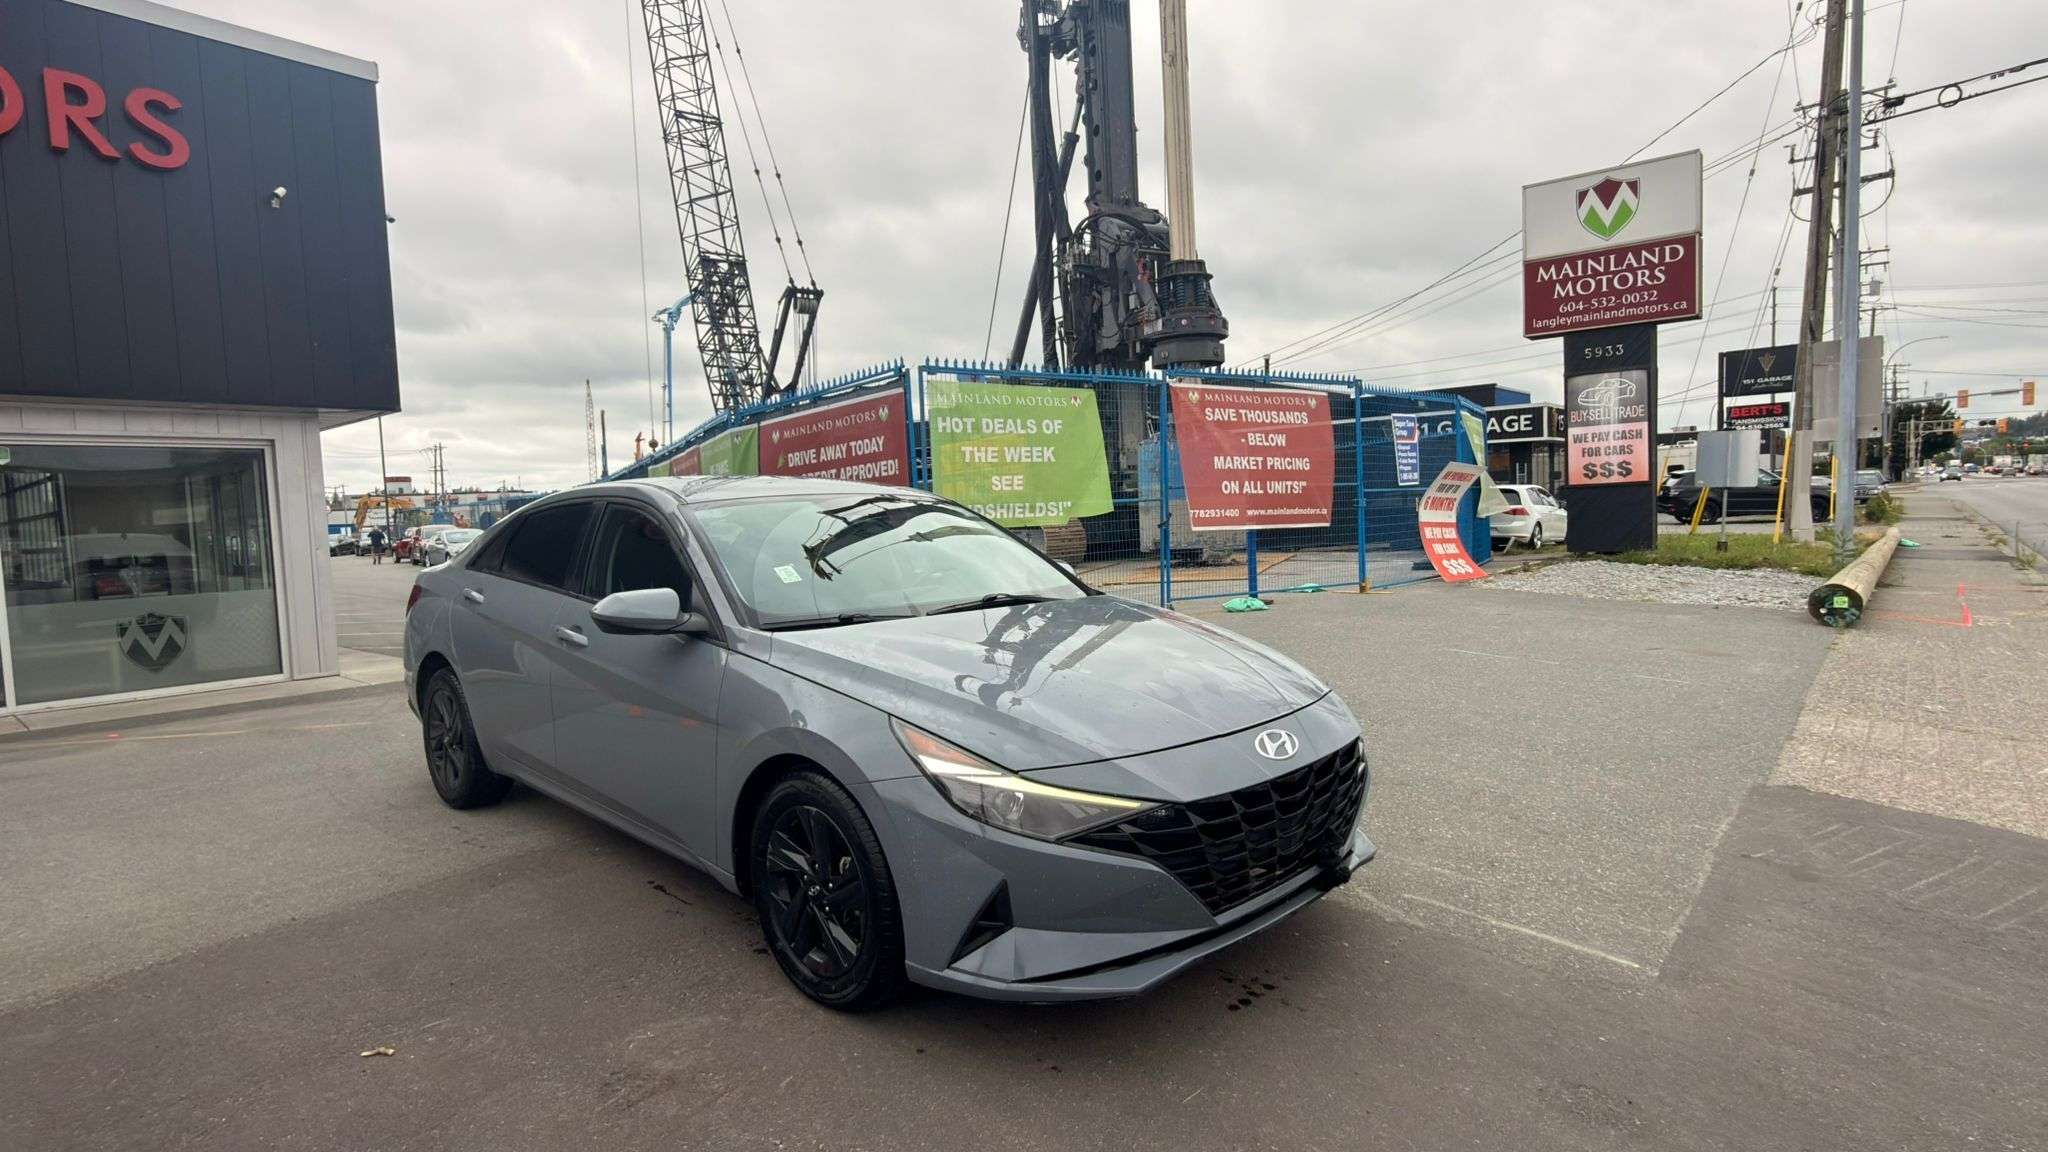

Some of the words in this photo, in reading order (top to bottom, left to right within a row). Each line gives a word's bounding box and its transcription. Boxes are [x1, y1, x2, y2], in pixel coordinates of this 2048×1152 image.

[1535, 244, 1685, 283] MAINLAND
[1553, 266, 1666, 299] MOTORS
[1559, 290, 1658, 313] 604-532-0032
[1532, 300, 1688, 328] langleymainlandmotors.ca
[1584, 344, 1624, 359] 5933
[936, 392, 1011, 406] MAINLAND
[1015, 396, 1067, 408] MOTORS
[1204, 393, 1261, 404] MAINLAND
[1264, 396, 1306, 407] MOTORS
[1205, 407, 1237, 421] SAVE
[1239, 409, 1308, 424] THOUSANDS
[1731, 405, 1783, 418] BERT'S
[783, 419, 833, 439] MAINLAND
[835, 409, 876, 427] MOTORS
[937, 416, 975, 433] HOT
[981, 418, 1037, 434] DEALS
[1042, 419, 1063, 434] OF
[1248, 432, 1286, 447] BELOW
[1572, 433, 1589, 443] WE
[1591, 431, 1611, 443] PAY
[1612, 428, 1643, 440] CASH
[788, 448, 817, 468] DRIVE
[820, 443, 848, 462] AWAY
[849, 435, 885, 456] TODAY
[961, 446, 998, 463] THE
[1003, 446, 1056, 463] WEEK
[1581, 446, 1604, 458] FOR
[1604, 443, 1634, 456] CARS
[839, 459, 899, 481] APPROVED!
[1214, 456, 1263, 470] MARKET
[1266, 457, 1311, 470] PRICING
[1582, 460, 1633, 480] $$$
[991, 475, 1024, 491] SEE
[1221, 480, 1240, 494] ON
[1243, 480, 1264, 494] ALL
